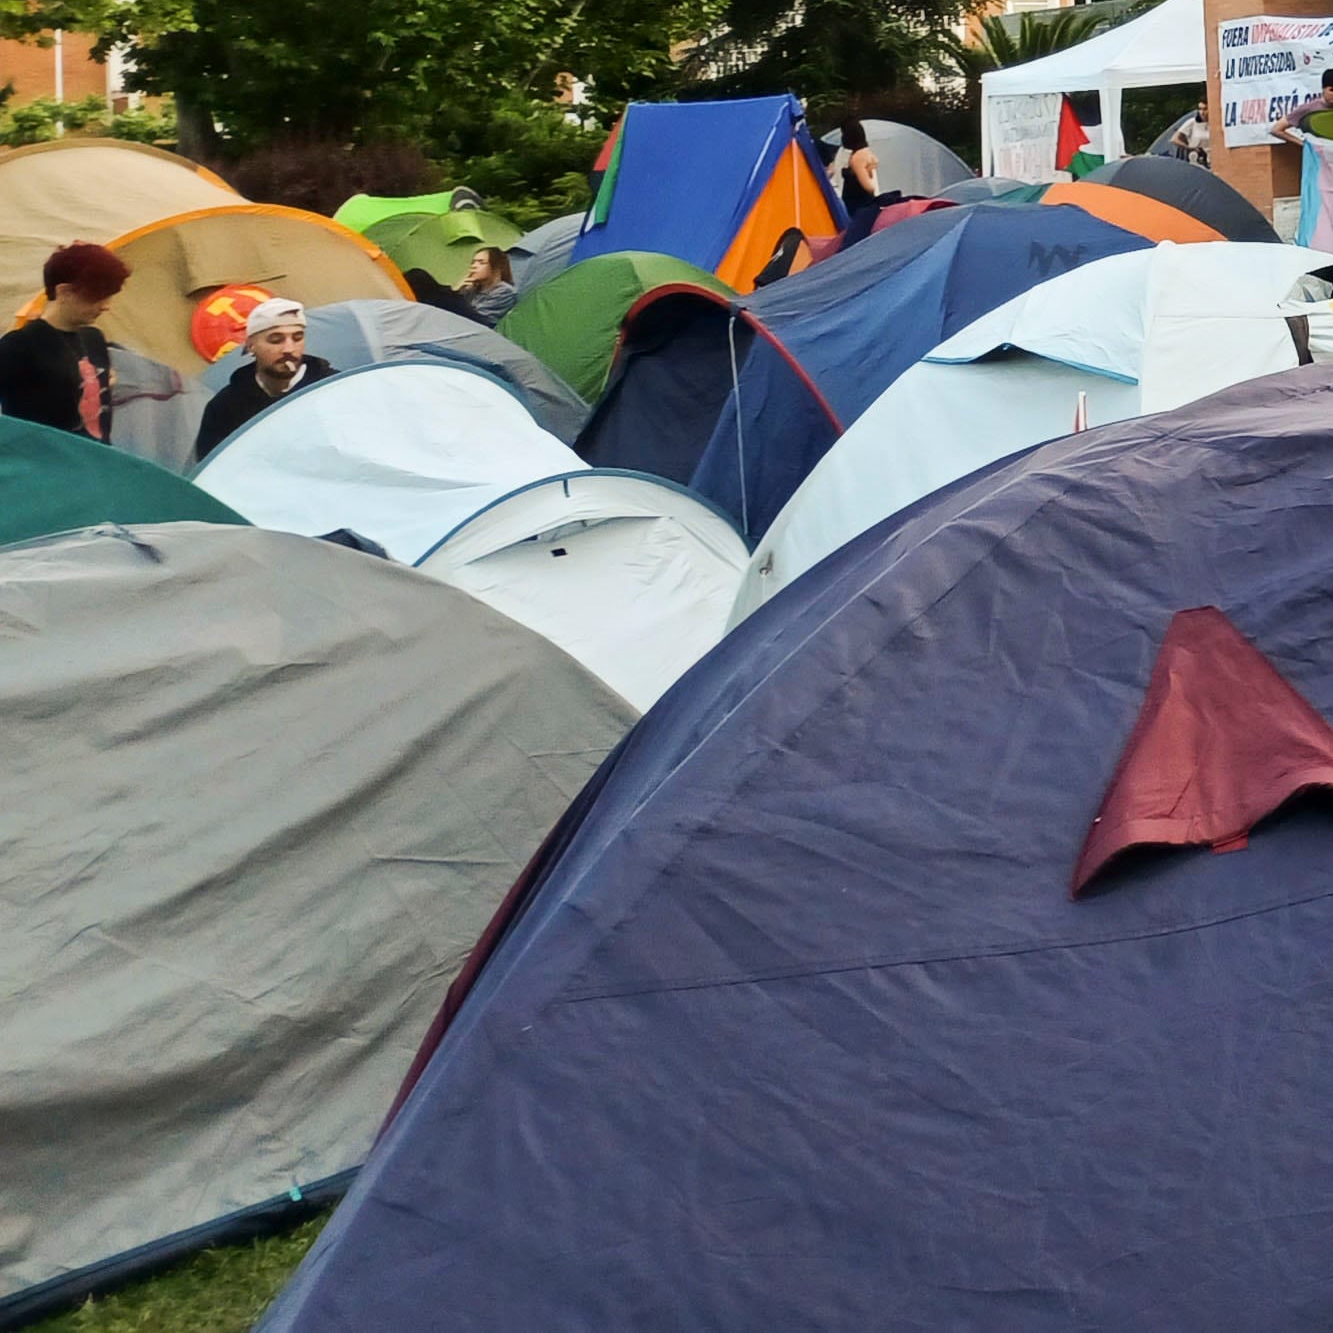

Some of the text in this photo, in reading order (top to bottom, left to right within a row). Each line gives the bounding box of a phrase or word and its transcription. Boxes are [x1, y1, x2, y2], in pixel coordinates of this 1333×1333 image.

[1222, 26, 1250, 49] FUERA
[1225, 51, 1296, 79] LA UNIVERSIDAD
[1225, 102, 1237, 127] LA
[1269, 89, 1298, 122] ESTÁ
